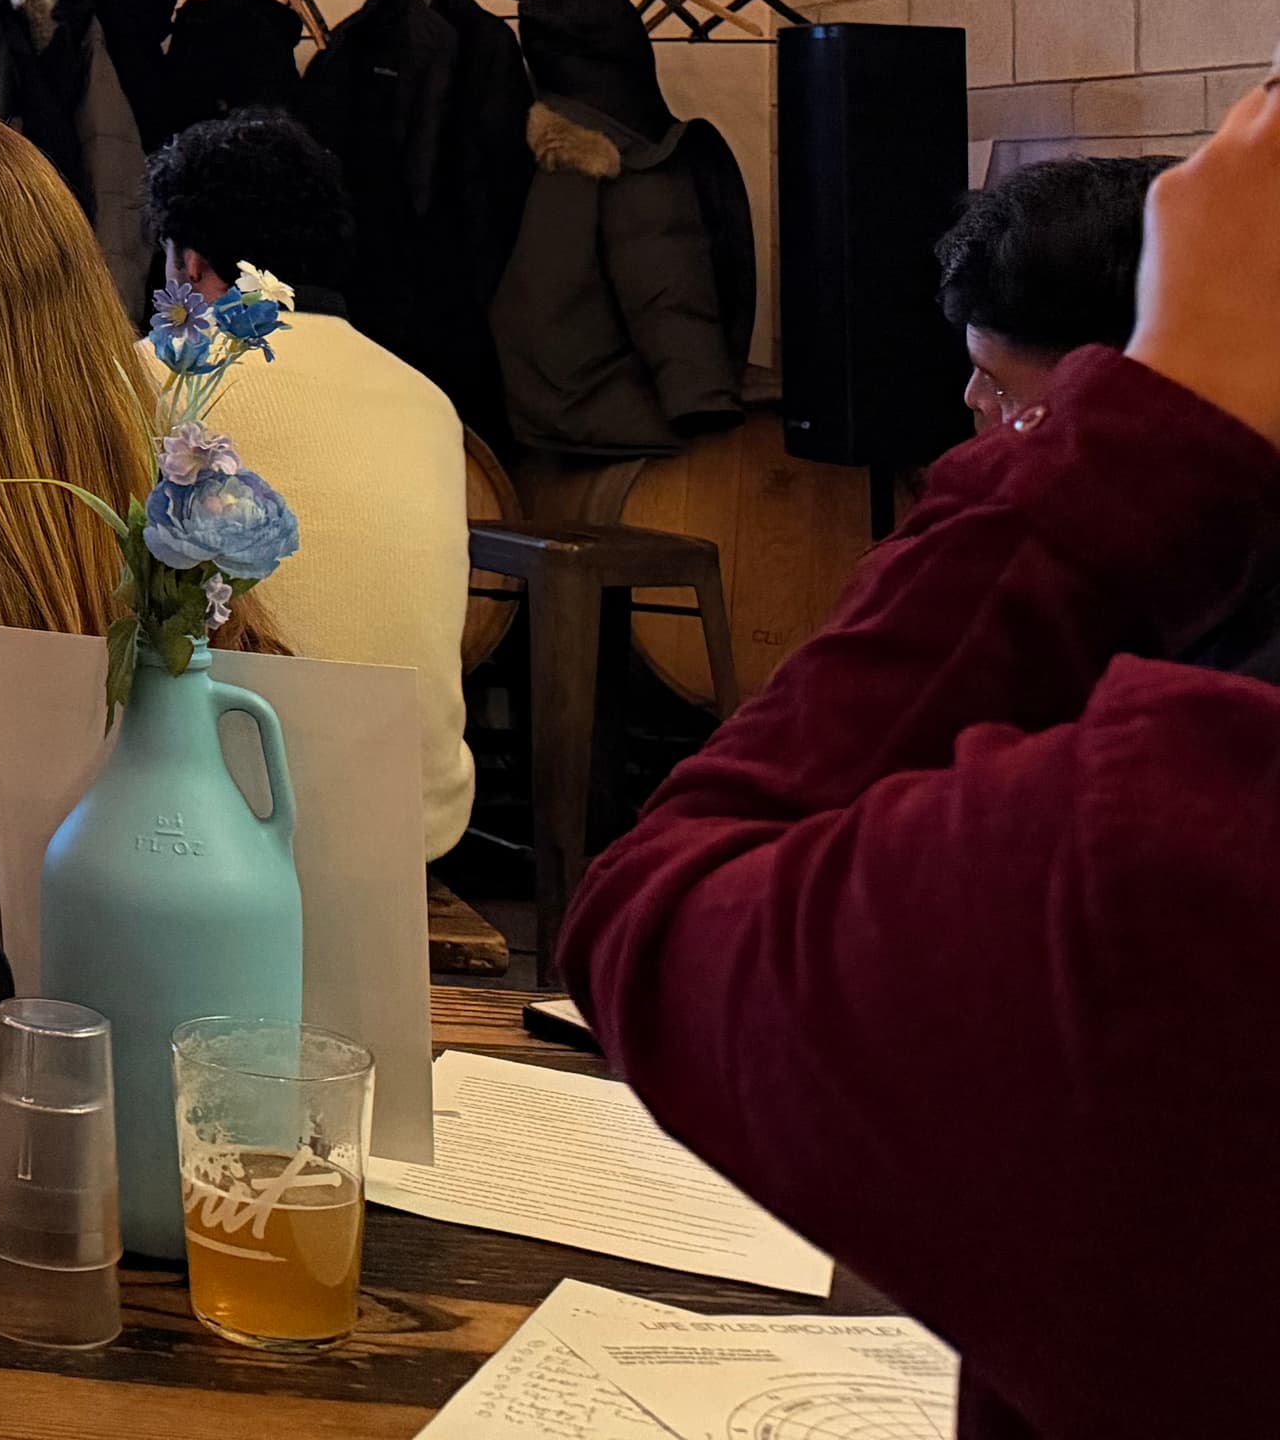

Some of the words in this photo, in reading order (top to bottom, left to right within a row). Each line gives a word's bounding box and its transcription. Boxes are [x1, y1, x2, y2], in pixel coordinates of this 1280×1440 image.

[639, 1320, 689, 1333] LIFE
[690, 1322, 768, 1334] STYLES
[769, 1323, 910, 1338] CIRCUMPLEX
